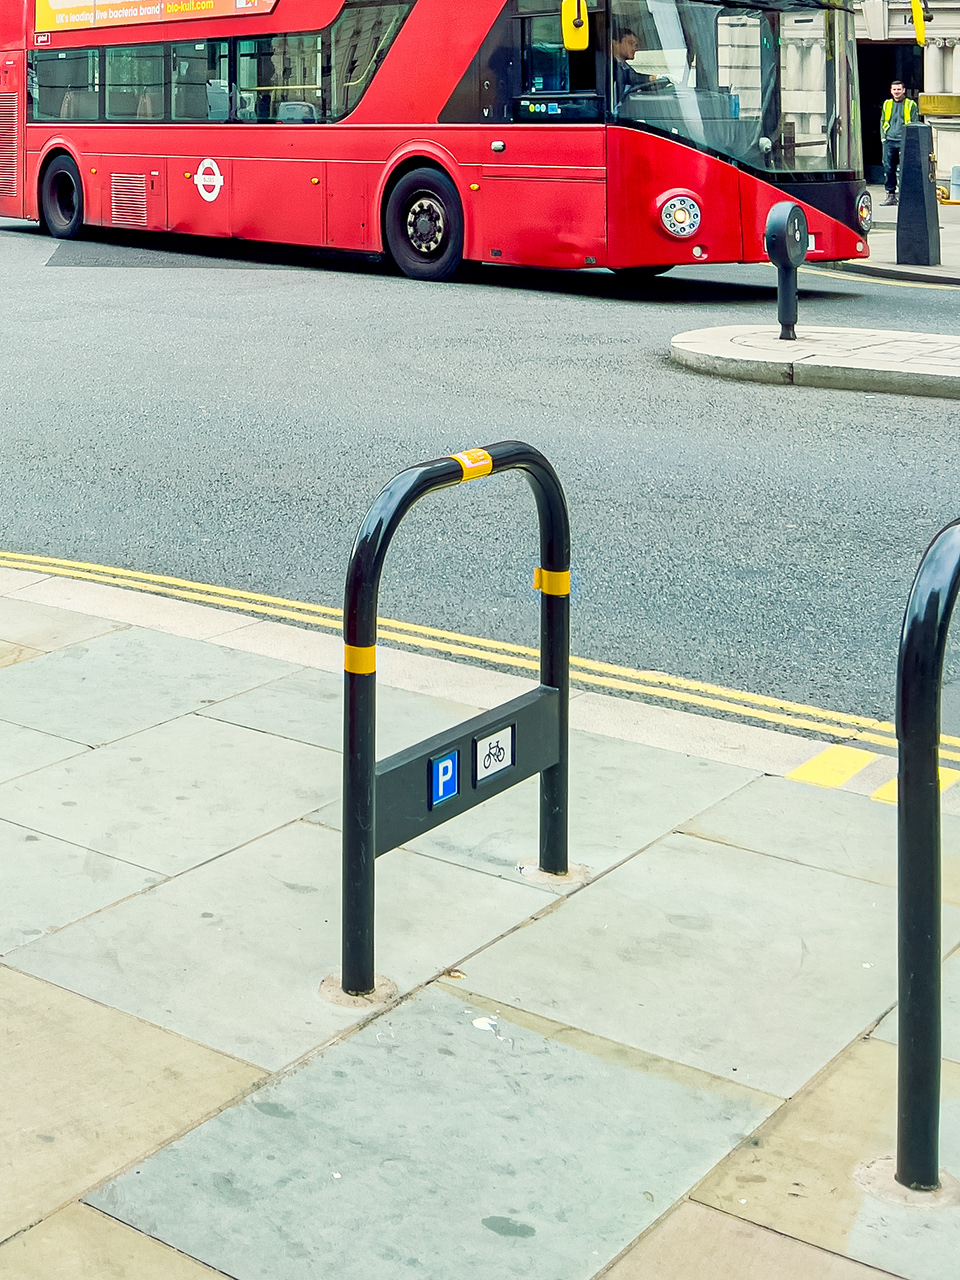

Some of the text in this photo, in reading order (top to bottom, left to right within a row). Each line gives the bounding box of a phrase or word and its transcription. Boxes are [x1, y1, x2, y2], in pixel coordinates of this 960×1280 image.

[55, 13, 69, 24] UK's
[69, 11, 93, 24] leading
[95, 10, 107, 20] live
[108, 6, 138, 19] bacteria
[166, 0, 214, 14] bio-kult.com
[438, 759, 453, 797] P
